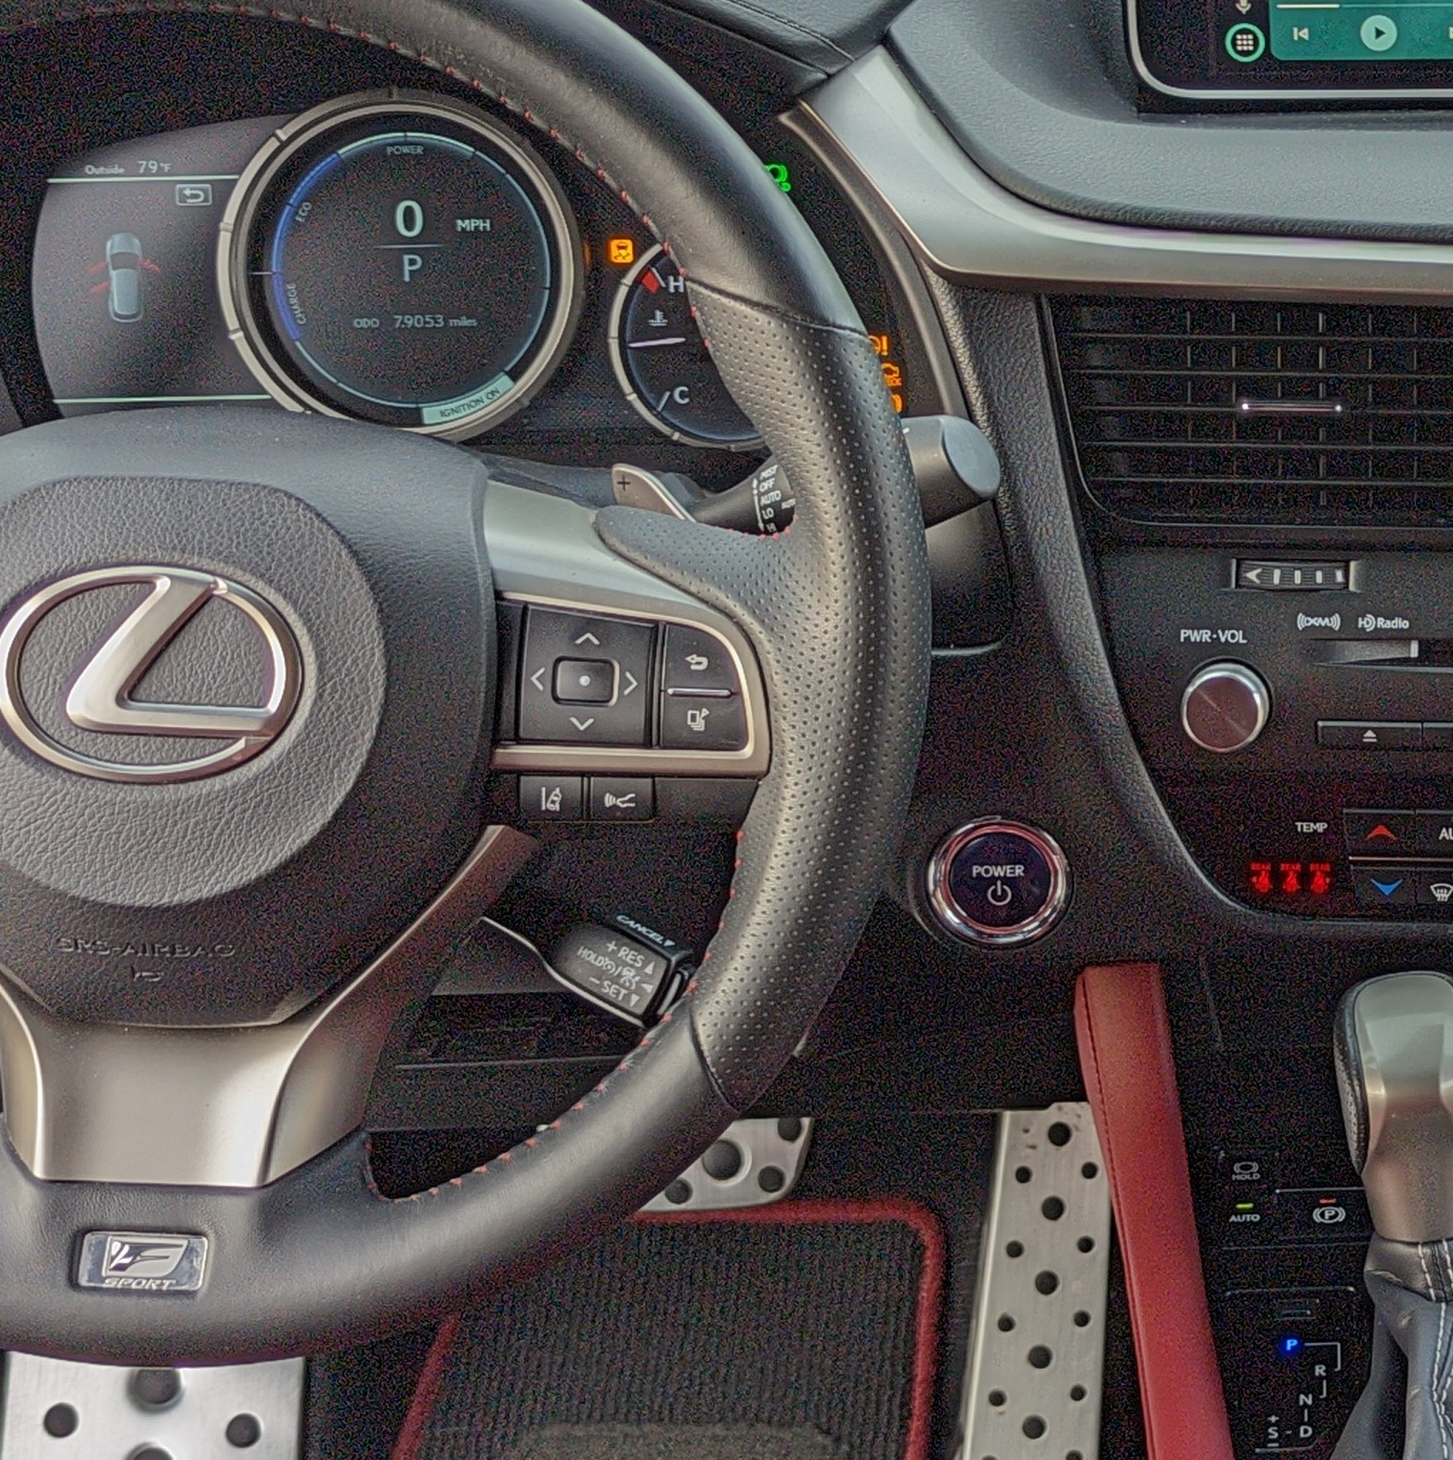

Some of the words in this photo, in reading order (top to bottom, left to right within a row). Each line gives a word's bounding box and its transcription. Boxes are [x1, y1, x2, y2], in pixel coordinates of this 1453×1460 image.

[387, 146, 424, 155] POWER
[85, 164, 125, 175] Outside
[296, 201, 312, 223] ECO
[396, 200, 423, 237] 0
[456, 219, 490, 231] MPH
[402, 254, 422, 281] P
[668, 275, 685, 293] H
[287, 284, 306, 325] CHARGE
[353, 317, 379, 328] ODO
[394, 315, 444, 327] 79053
[449, 317, 478, 327] miles
[673, 386, 690, 404] C
[439, 396, 484, 418] IGNITION
[485, 387, 501, 401] ON
[759, 478, 775, 492] OFF
[760, 490, 781, 506] AUTO
[761, 507, 774, 519] LO
[1377, 617, 1409, 630] Radio
[1295, 821, 1328, 833] TEMP
[972, 865, 1025, 878] POWER
[616, 914, 664, 945] CANCEL
[577, 946, 604, 967] HOLD
[618, 946, 645, 968] RES
[601, 978, 628, 1002] SET
[1232, 1170, 1260, 1181] HOLD
[1229, 1213, 1260, 1223] AUTO
[102, 1276, 177, 1291] SPORT
[1286, 1339, 1298, 1351] P
[1315, 1365, 1327, 1377] R
[1299, 1394, 1313, 1407] N
[1268, 1426, 1278, 1439] S
[1300, 1426, 1313, 1438] D
